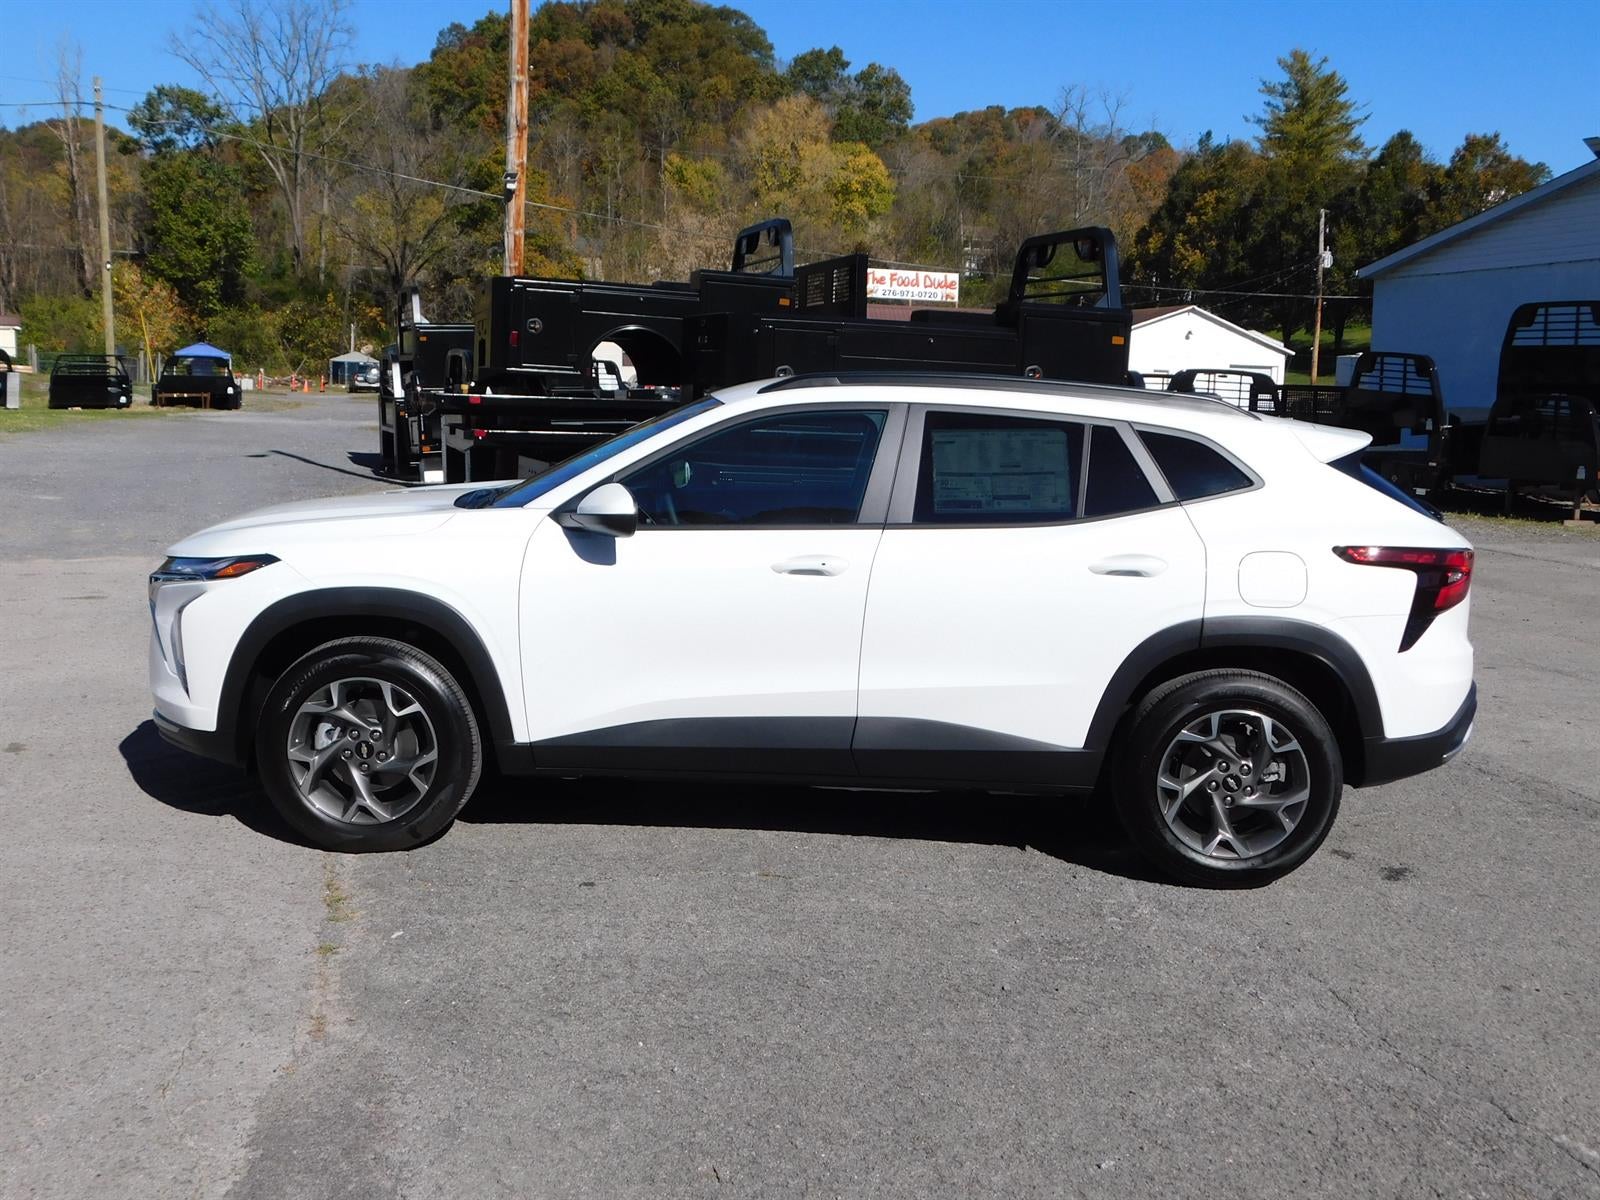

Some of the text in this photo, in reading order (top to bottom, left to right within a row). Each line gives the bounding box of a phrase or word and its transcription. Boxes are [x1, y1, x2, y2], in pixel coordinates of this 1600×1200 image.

[866, 271, 957, 290] The Food Dude
[882, 289, 938, 299] 276-971-0720
